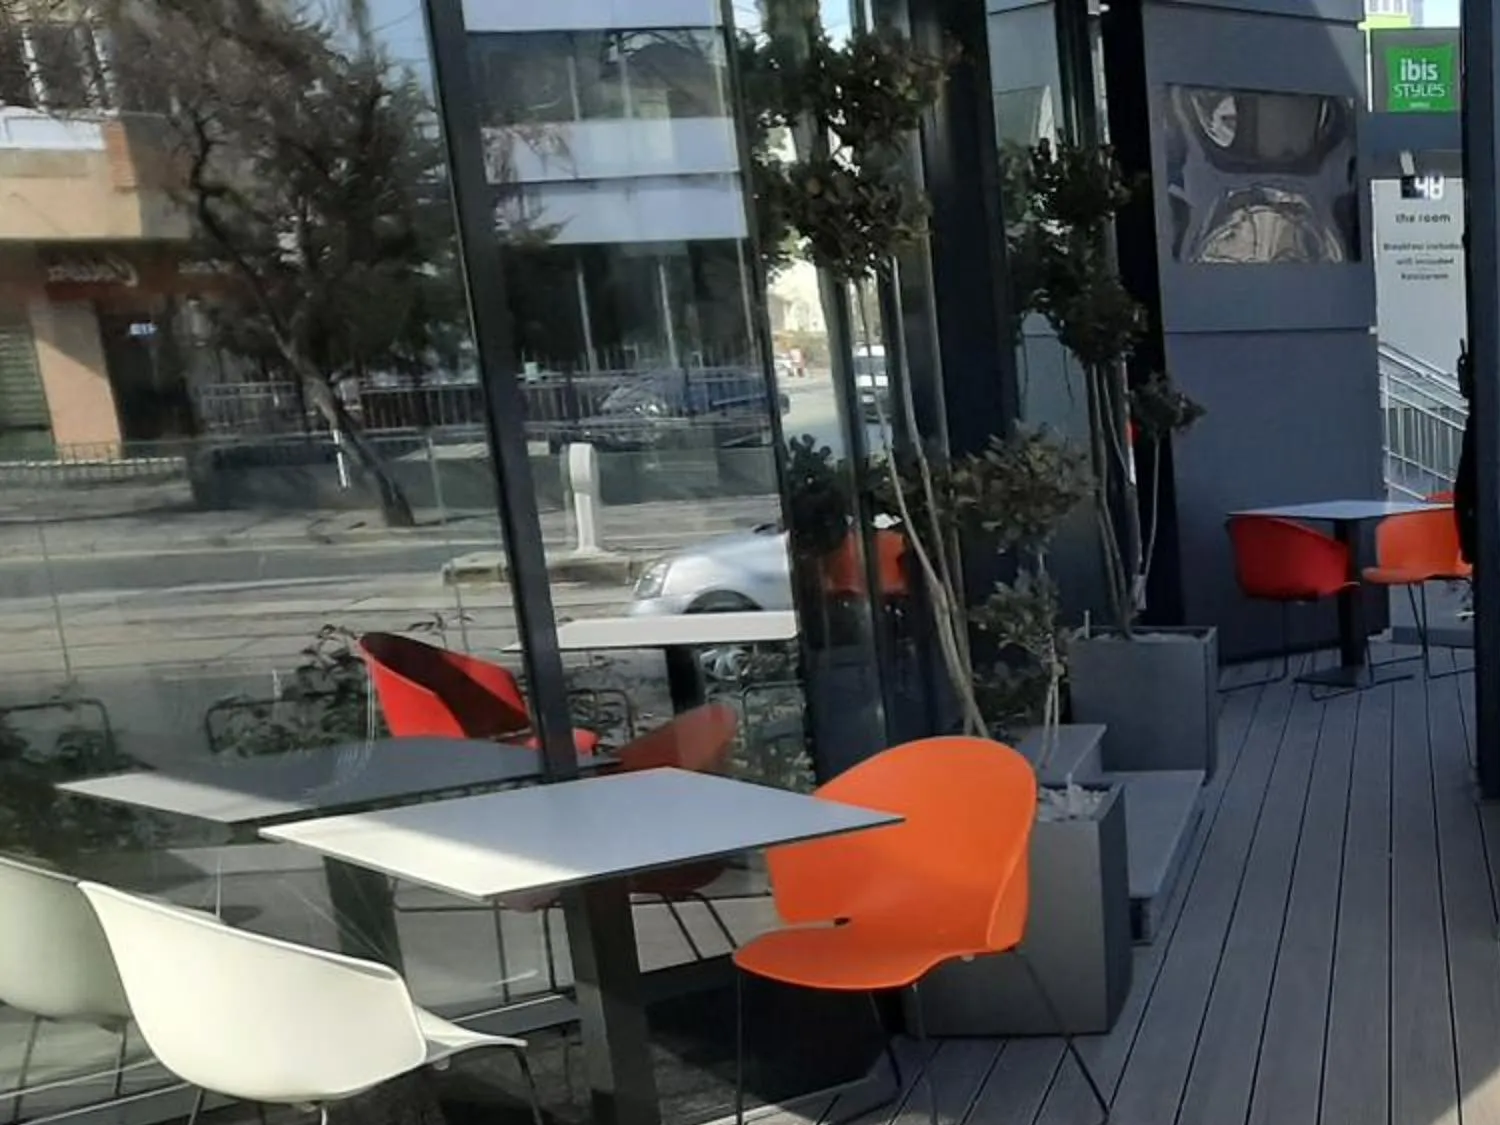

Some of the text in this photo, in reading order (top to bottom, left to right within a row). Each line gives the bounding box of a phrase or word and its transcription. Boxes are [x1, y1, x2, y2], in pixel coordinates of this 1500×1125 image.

[1401, 57, 1438, 81] ibis
[1393, 83, 1445, 99] STYLES
[1418, 214, 1452, 223] room
